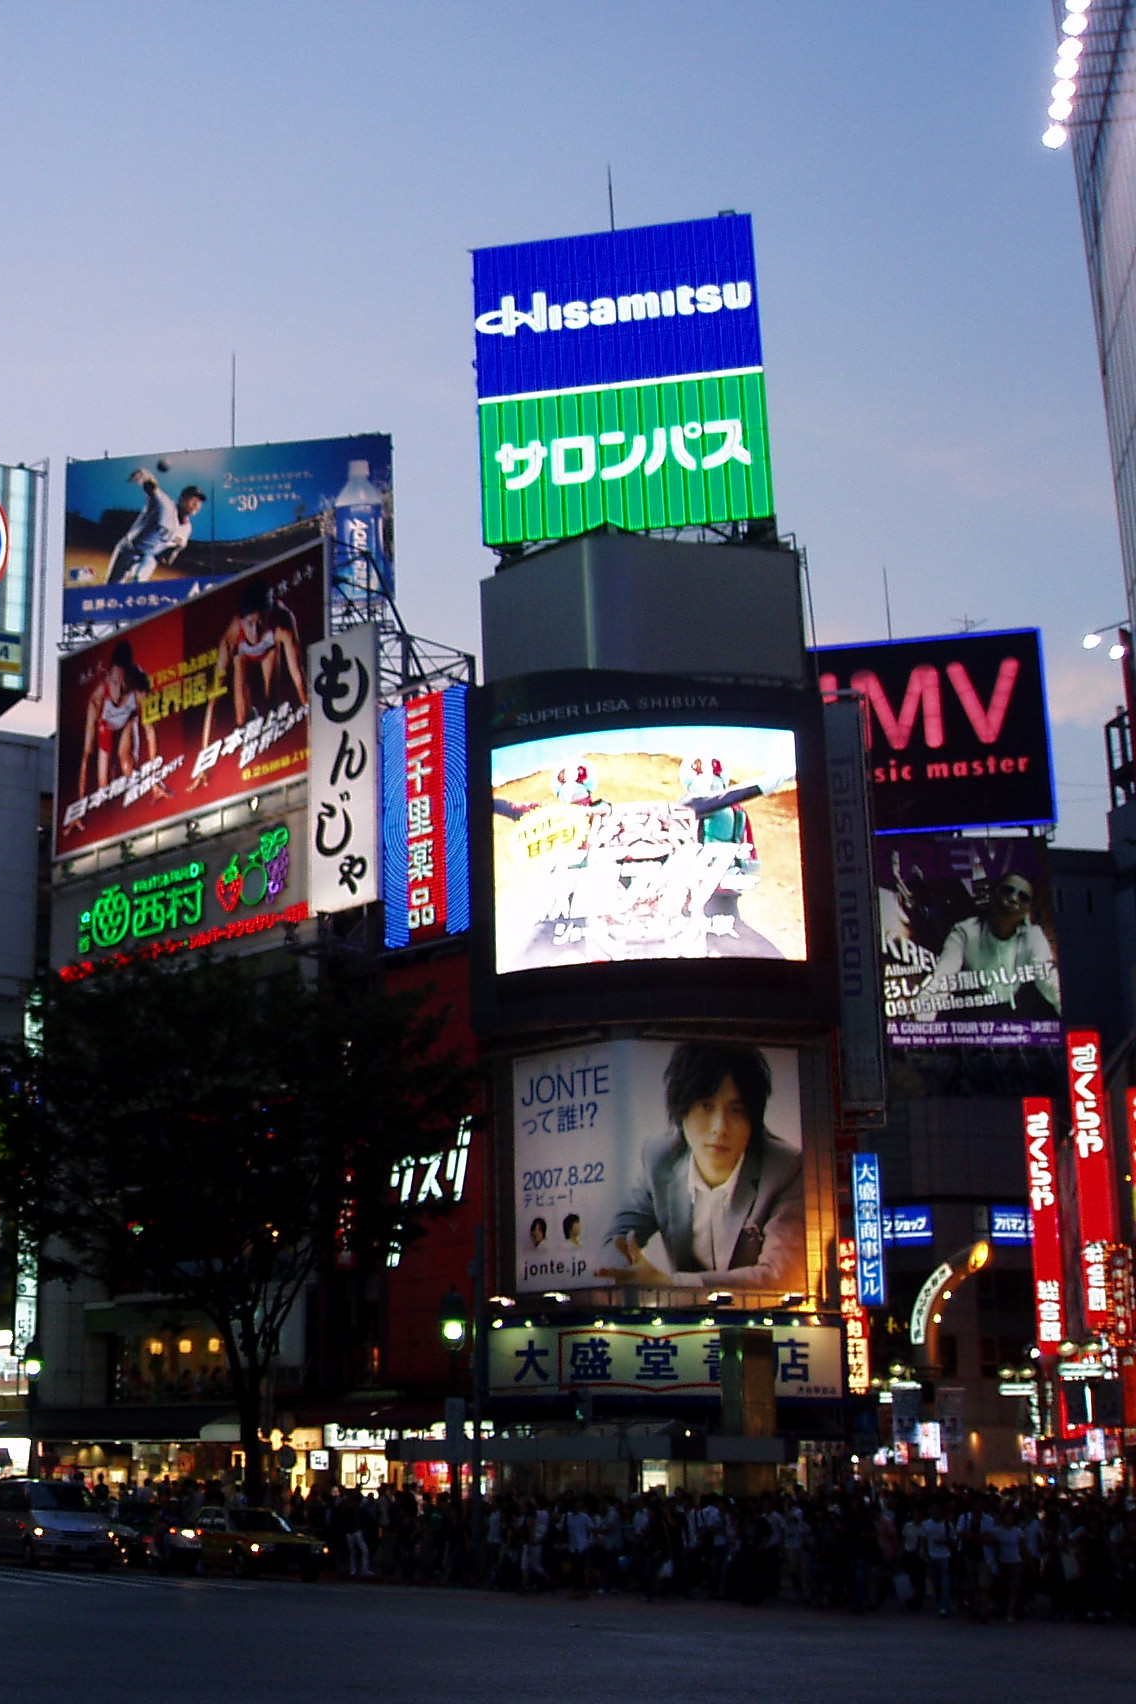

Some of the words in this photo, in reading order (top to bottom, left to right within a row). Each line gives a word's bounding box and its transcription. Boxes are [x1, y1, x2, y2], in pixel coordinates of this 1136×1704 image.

[475, 281, 752, 337] Hisamitsu
[495, 418, 752, 490] サロンパス
[516, 706, 580, 727] SUPER
[584, 699, 629, 714] LISA
[636, 695, 719, 709] SHIBUYA
[313, 644, 369, 894] もんじゃ
[868, 758, 913, 784] sic
[926, 754, 1030, 779] master
[407, 703, 435, 930] 三千里薬品
[527, 825, 577, 859] 甘デジ
[132, 879, 204, 938] 西村
[901, 1021, 948, 1034] CONCERT
[951, 1021, 978, 1034] TOUR
[521, 1064, 610, 1107] JONTE
[1071, 1043, 1104, 1158] さくらや
[522, 1102, 598, 1135] って誰!?
[523, 1162, 605, 1192] 2007.8.22
[1027, 1111, 1055, 1211] さくらや
[524, 1189, 574, 1208] デビュー!
[857, 1162, 880, 1297] 大盛堂商事ビル
[524, 1260, 586, 1280] jonte.jp
